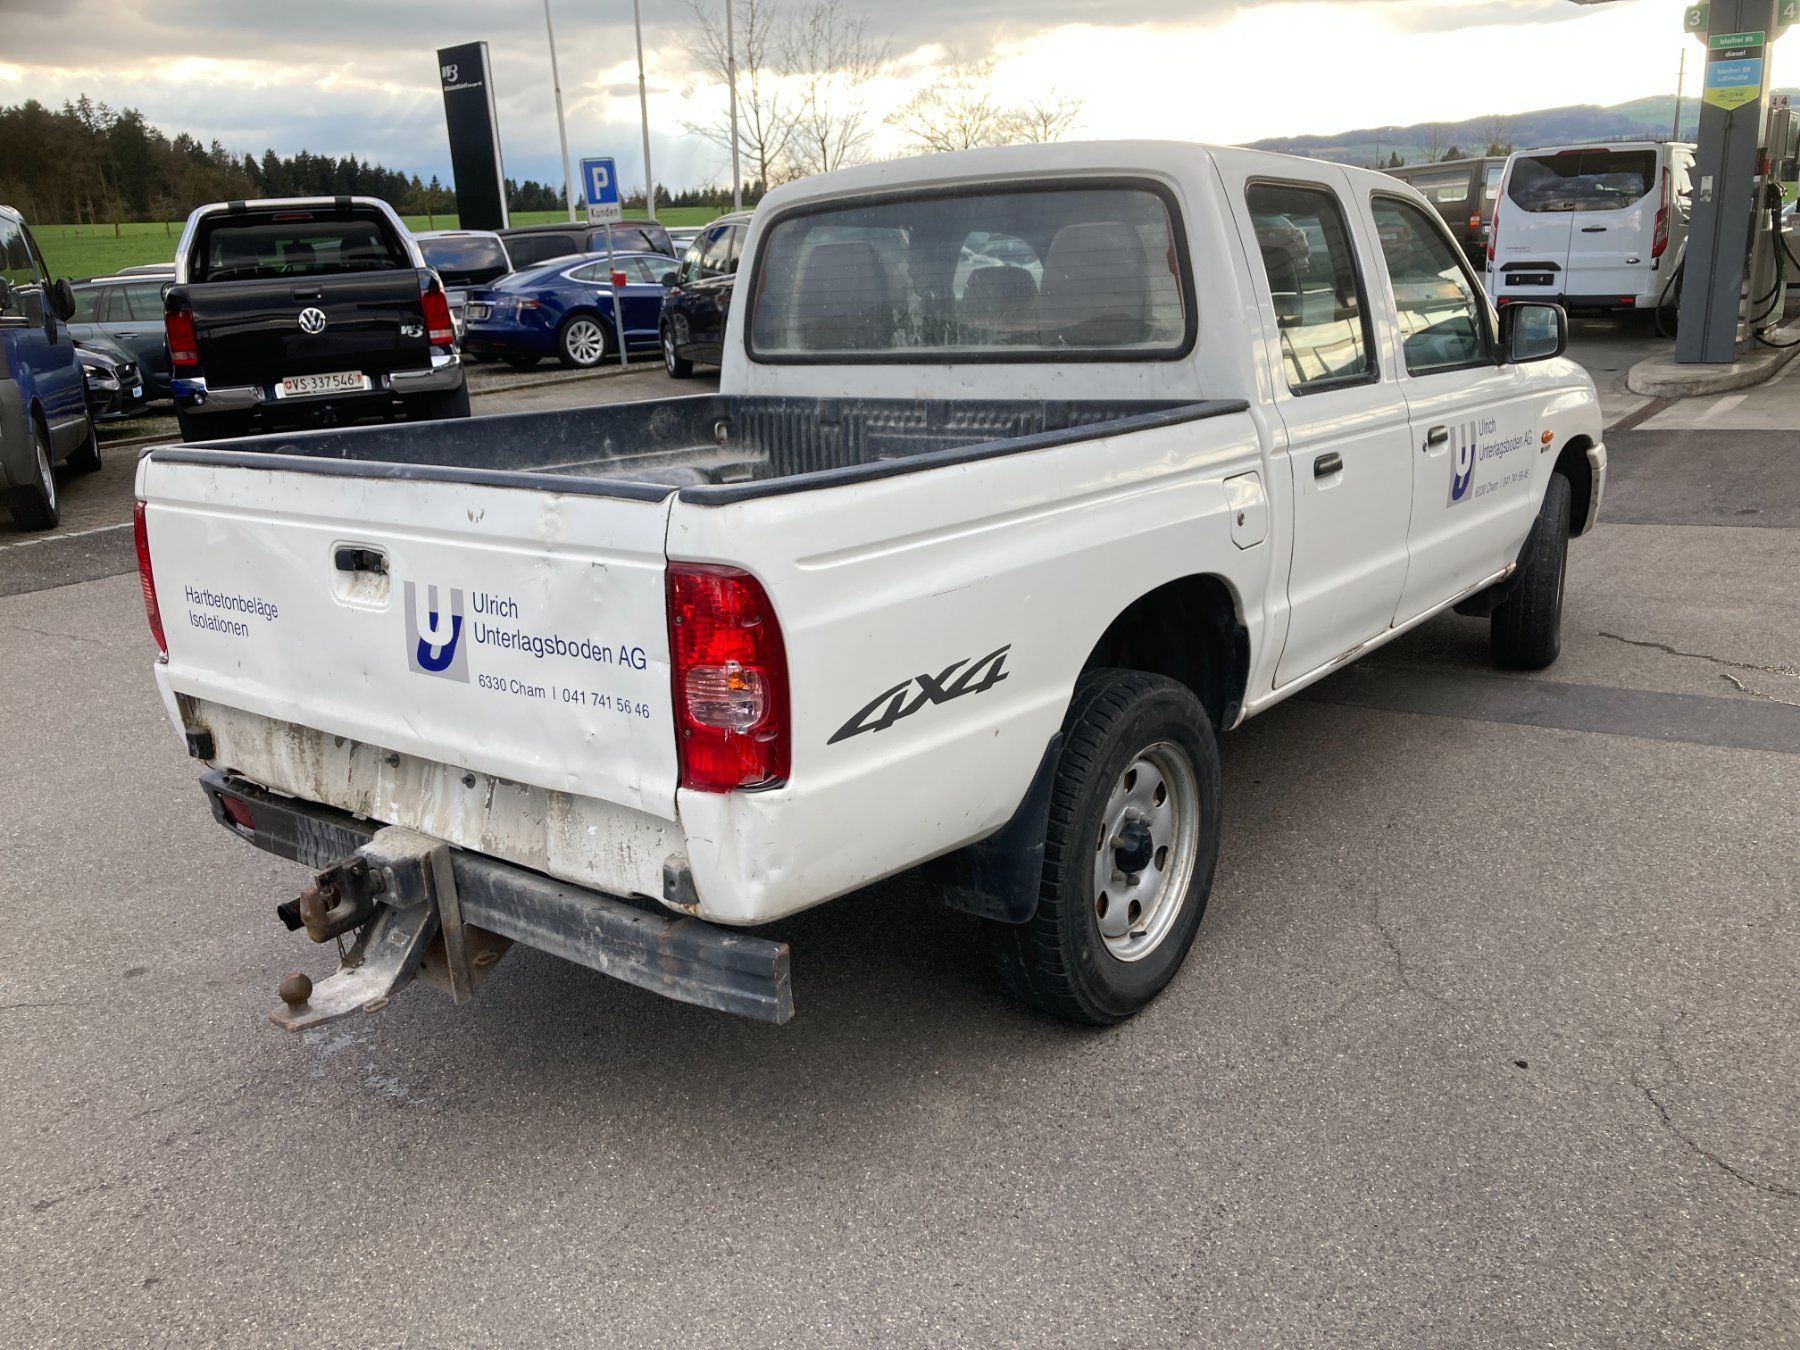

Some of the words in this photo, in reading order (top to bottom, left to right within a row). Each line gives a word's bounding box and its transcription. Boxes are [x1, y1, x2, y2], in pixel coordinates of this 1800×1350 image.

[1689, 10, 1701, 26] 3
[1784, 2, 1796, 18] 4
[592, 166, 609, 200] P
[1478, 417, 1497, 436] Ulrich
[184, 584, 279, 622] Hartbetonbeläge
[472, 591, 518, 619] Ulrich
[188, 609, 249, 637] Isolationen
[474, 622, 612, 664] Unterlagsboden
[618, 645, 647, 670] AG
[478, 674, 507, 692] 6330
[510, 679, 546, 699] Cham
[562, 688, 586, 705] 041
[591, 692, 612, 709] 741
[617, 698, 632, 714] 56
[634, 703, 650, 719] 46
